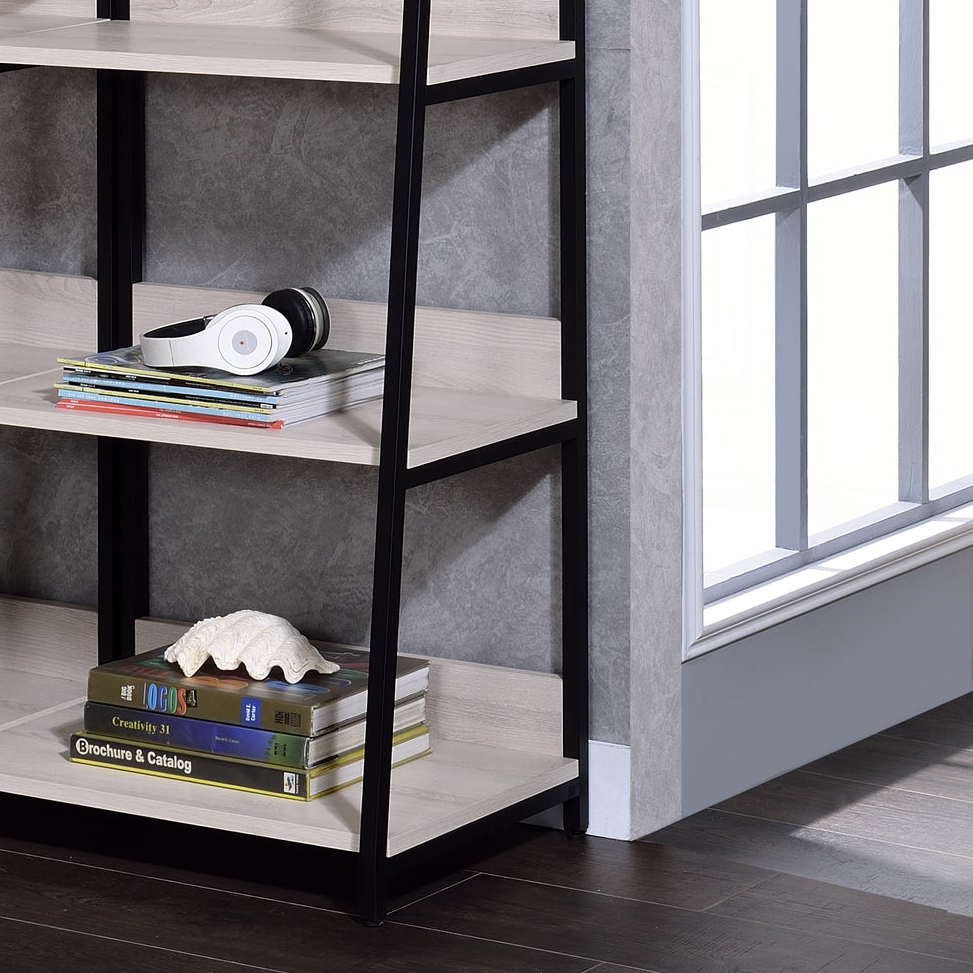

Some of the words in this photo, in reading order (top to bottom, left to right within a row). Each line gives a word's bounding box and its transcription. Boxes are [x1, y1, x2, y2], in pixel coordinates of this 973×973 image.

[112, 717, 157, 734] Creativity
[159, 724, 170, 735] 31
[76, 738, 133, 761] Brochure
[136, 749, 144, 762] &
[147, 751, 192, 773] Catalog
